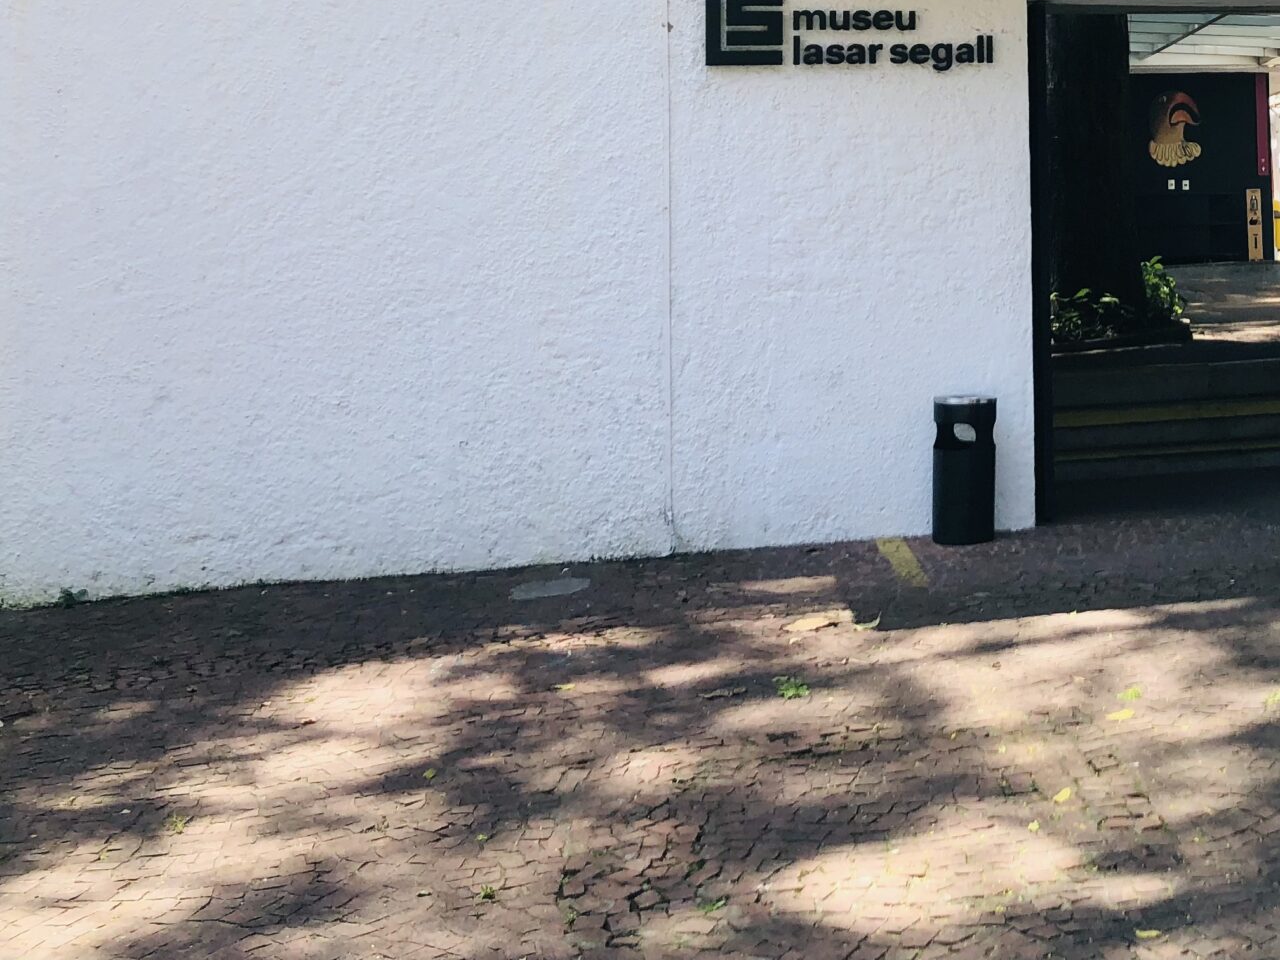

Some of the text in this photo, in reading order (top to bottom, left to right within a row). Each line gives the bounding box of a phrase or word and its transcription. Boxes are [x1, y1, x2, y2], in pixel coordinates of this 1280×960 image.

[792, 8, 917, 32] museu
[792, 34, 994, 72] lasar segall
